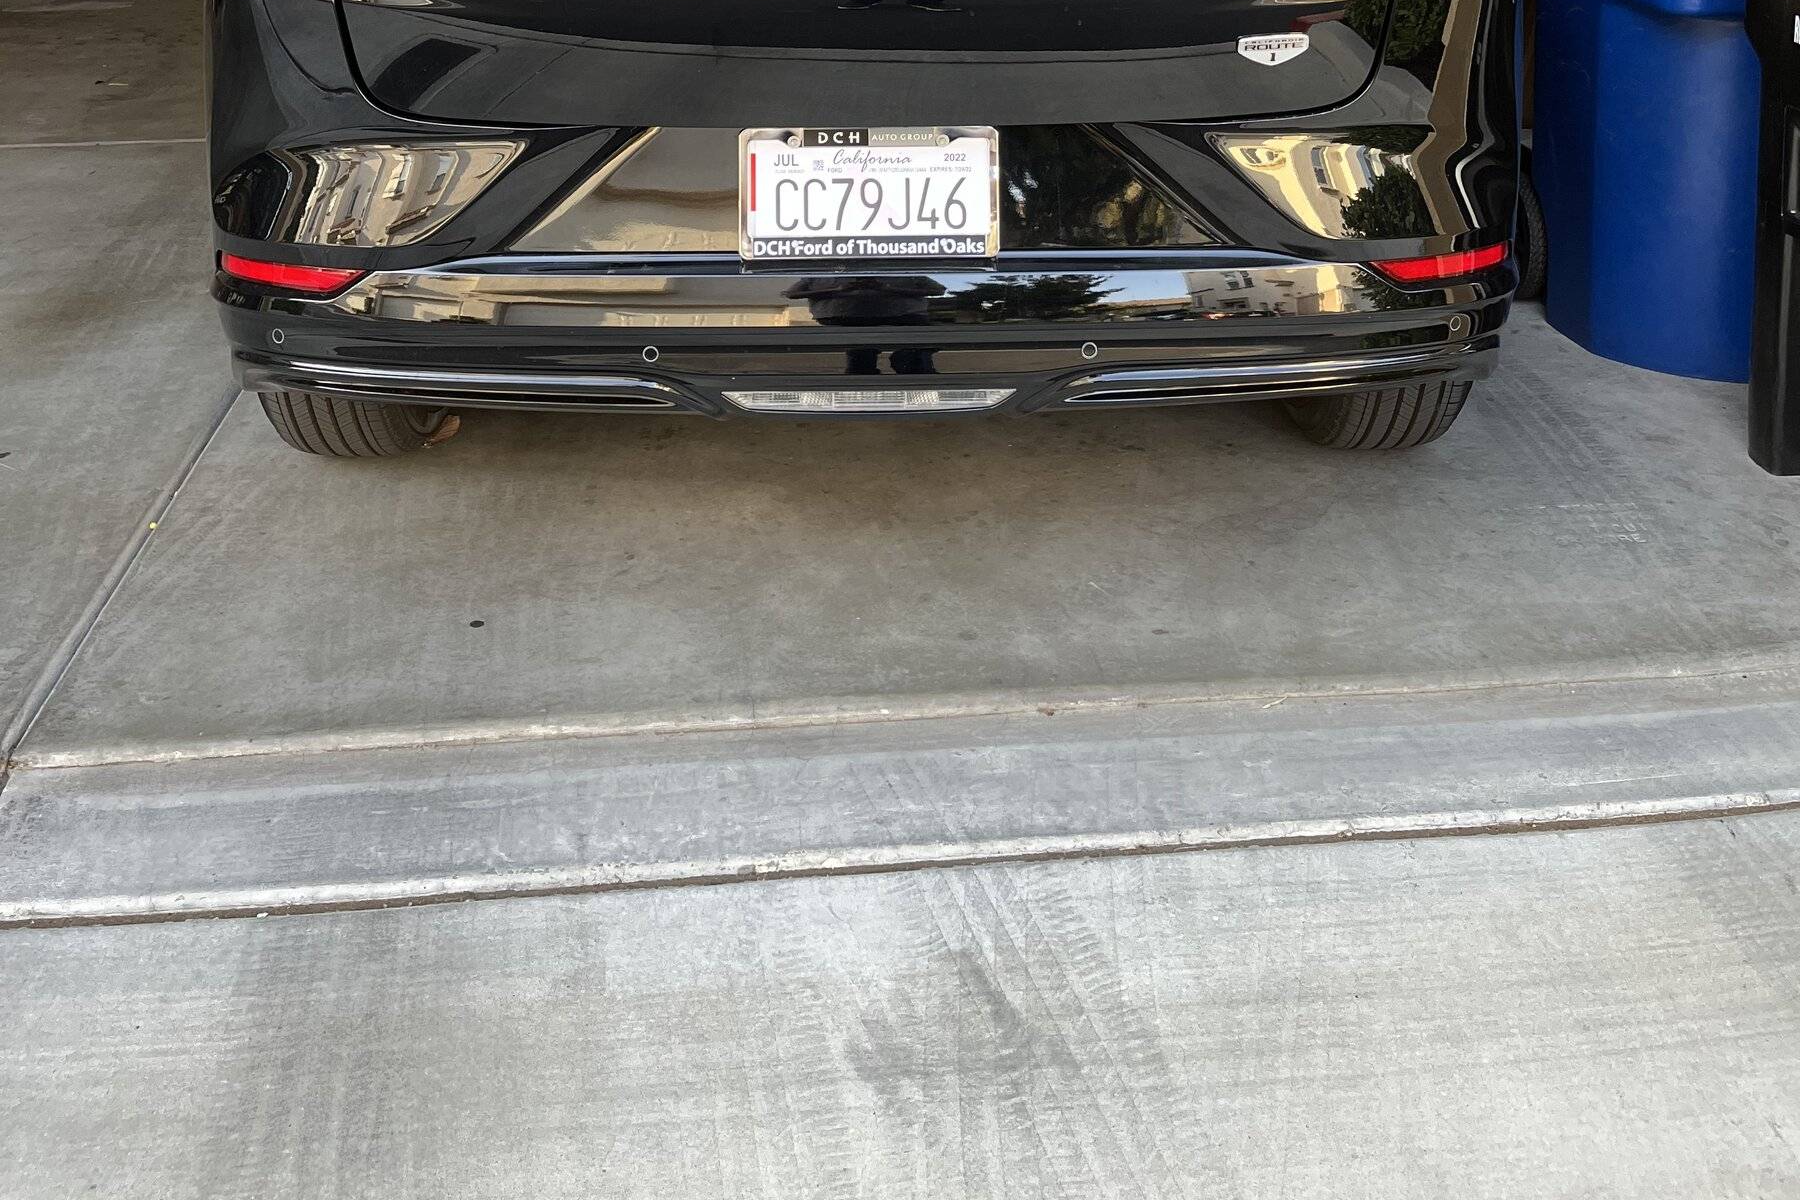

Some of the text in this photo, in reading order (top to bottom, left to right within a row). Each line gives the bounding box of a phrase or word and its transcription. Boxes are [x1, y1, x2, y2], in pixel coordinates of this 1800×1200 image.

[1244, 43, 1304, 51] ROUTE
[1270, 52, 1276, 62] 1
[817, 131, 861, 144] DCH
[871, 133, 934, 141] AUTO GROUP
[774, 154, 799, 167] JUL
[832, 149, 913, 173] California
[943, 153, 967, 162] 2022
[775, 177, 967, 231] CC79J46
[753, 237, 985, 256] DCH Ford of Thousand Oaks
